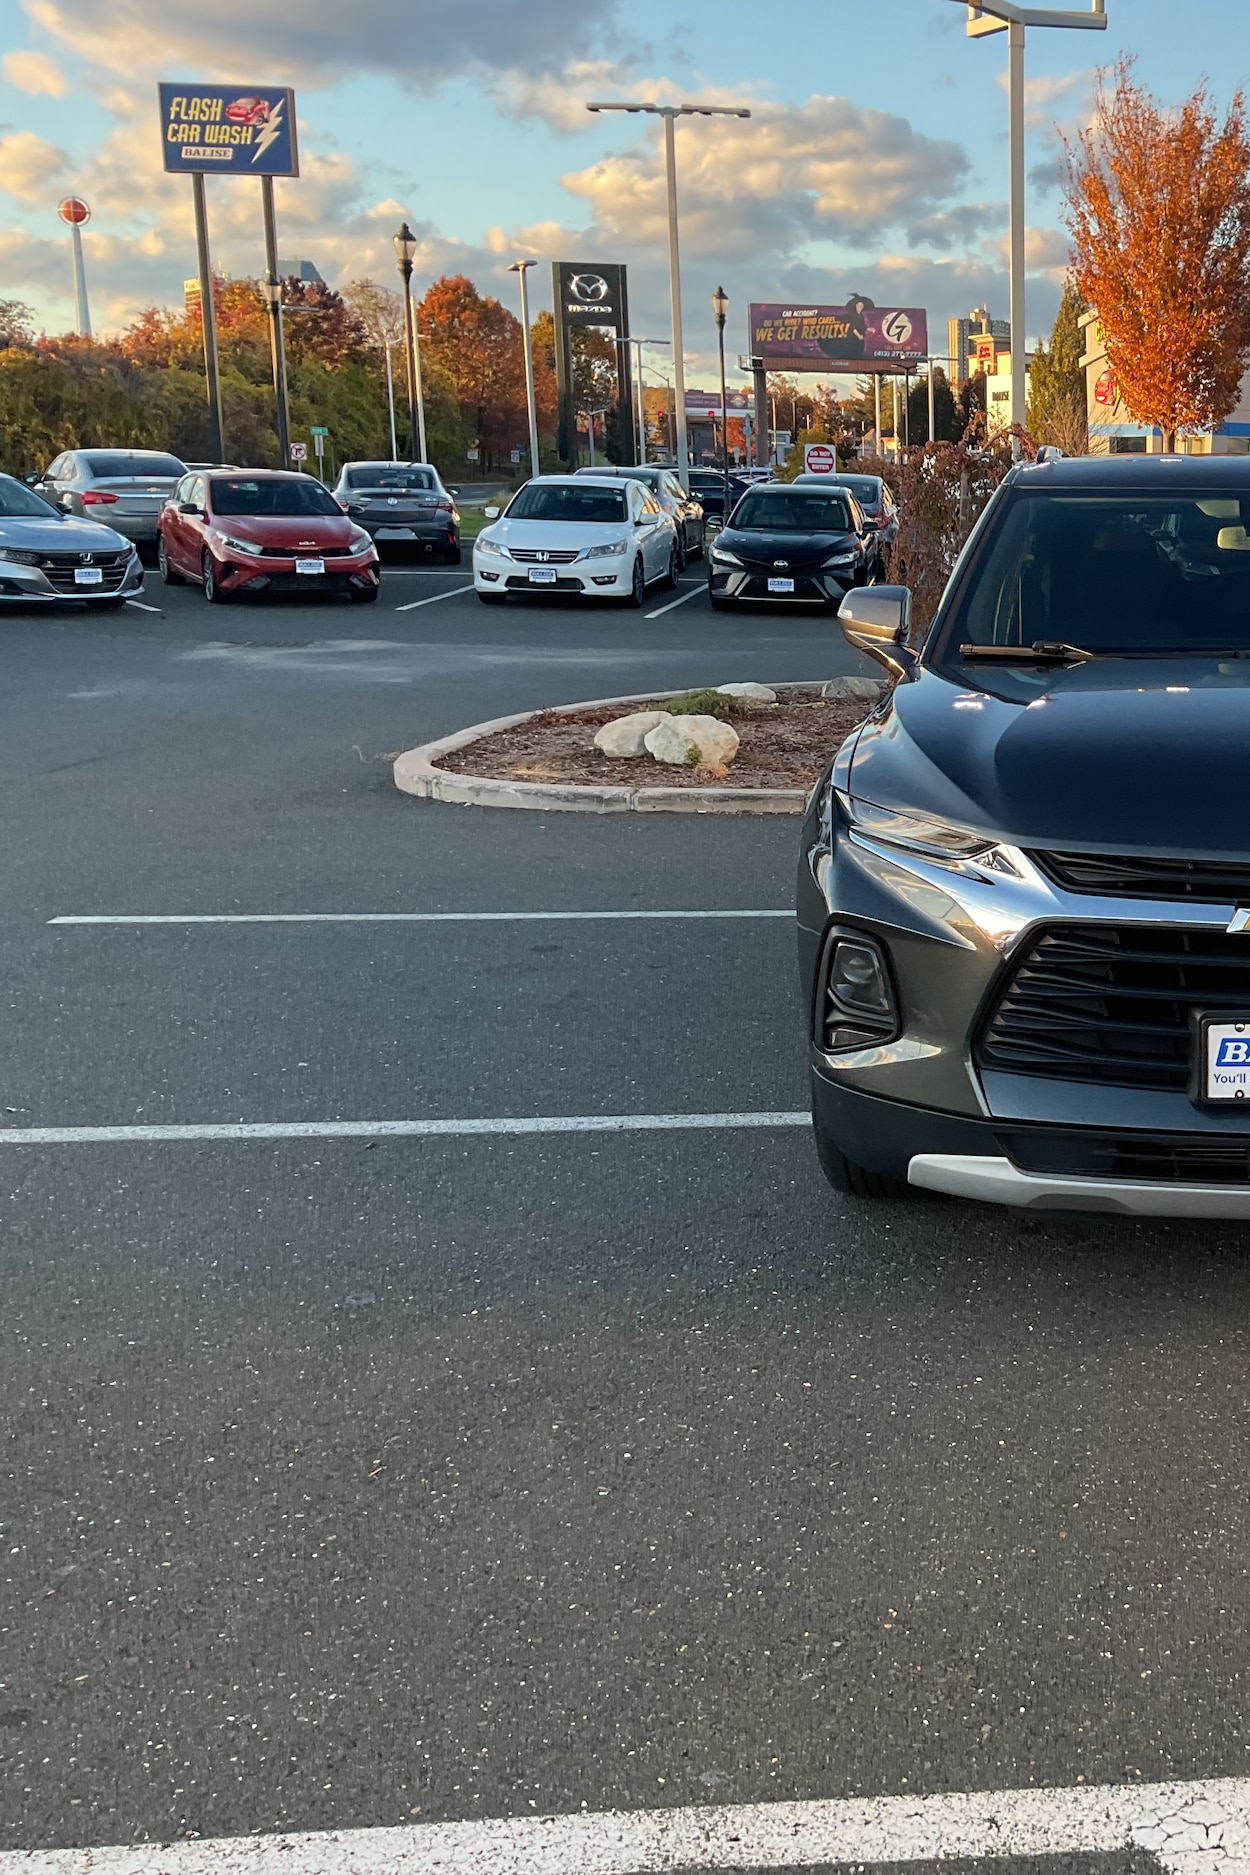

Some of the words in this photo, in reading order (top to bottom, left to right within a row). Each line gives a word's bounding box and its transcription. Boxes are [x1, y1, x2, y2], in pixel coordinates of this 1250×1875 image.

[169, 97, 222, 121] FLASH
[167, 123, 201, 143] CAR
[204, 124, 253, 145] WASH
[184, 148, 230, 158] BALISE
[755, 327, 774, 342] WE
[777, 326, 798, 340] GET
[801, 322, 850, 340] RESULTS!
[1213, 1073, 1247, 1084] You'll
